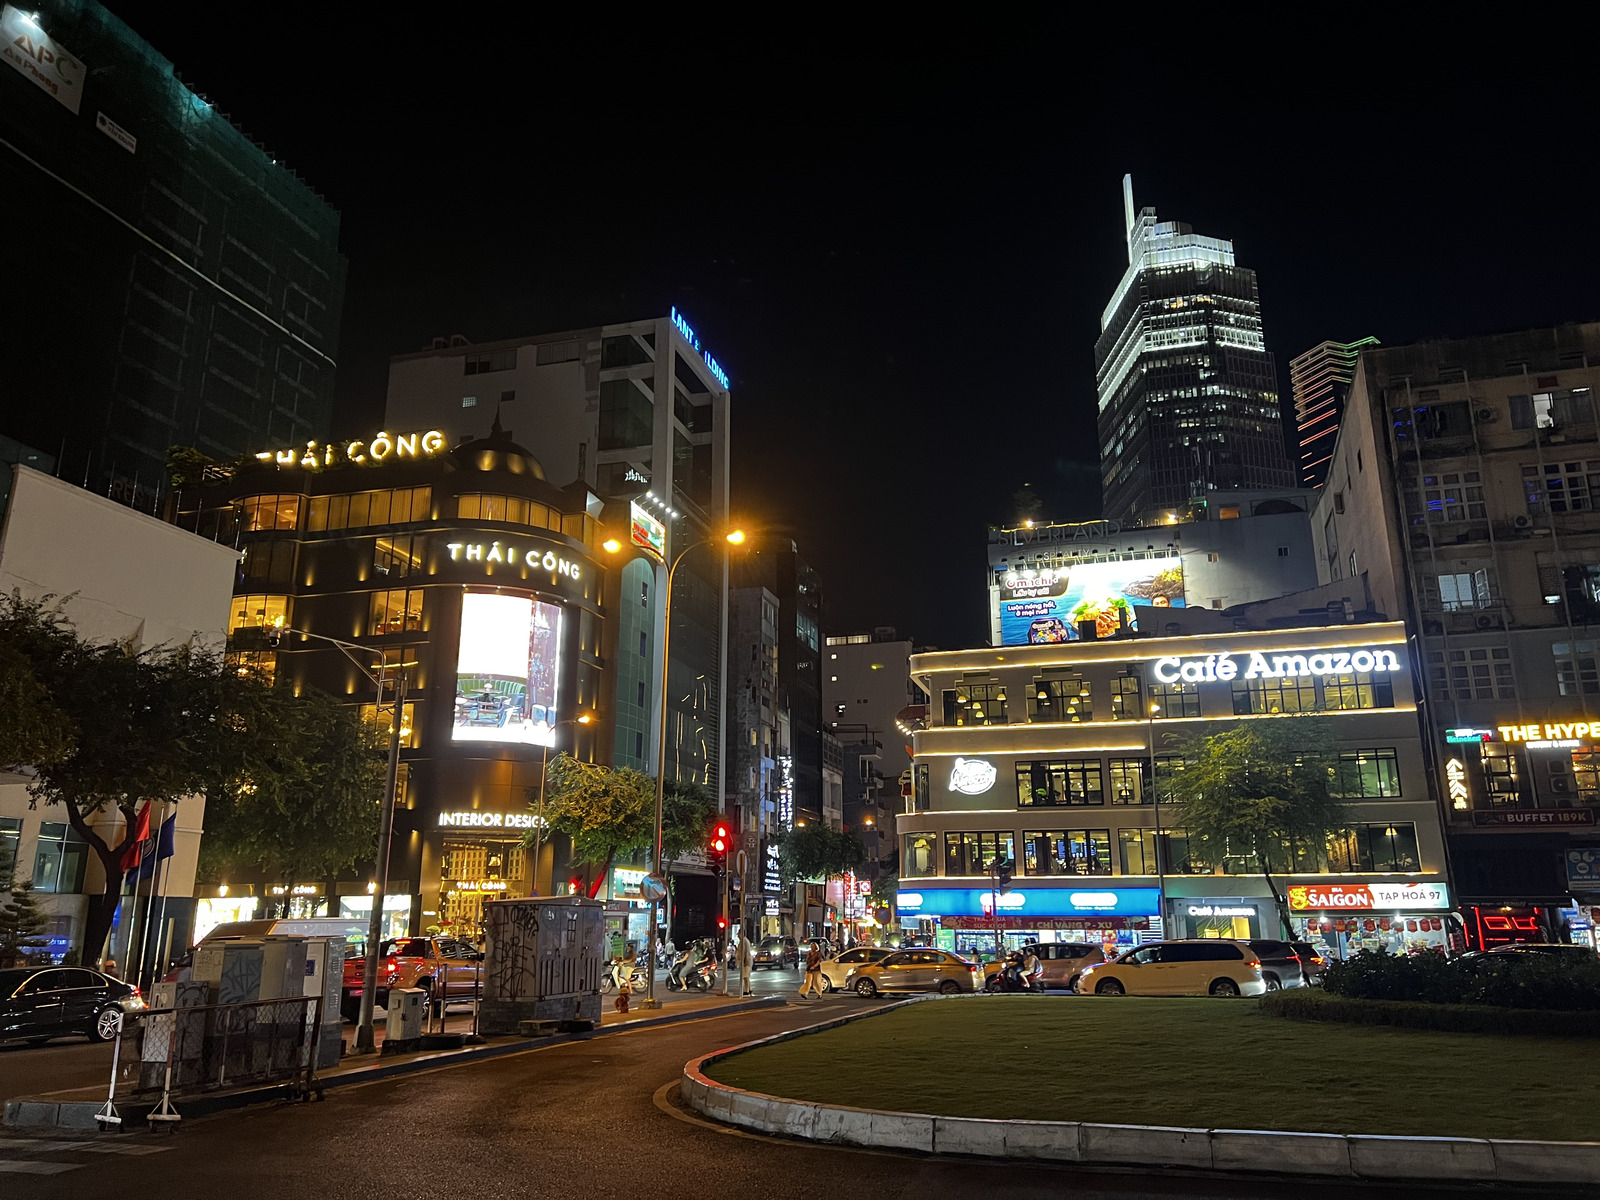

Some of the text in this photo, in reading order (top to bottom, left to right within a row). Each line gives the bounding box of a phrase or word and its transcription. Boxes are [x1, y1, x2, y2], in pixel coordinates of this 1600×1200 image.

[13, 33, 79, 86] APC
[346, 431, 443, 462] CÔNG
[998, 520, 1120, 548] SILVERLAND
[446, 541, 580, 580] THÁI CÔNG
[1027, 548, 1090, 562] HOSPIALTY
[1154, 649, 1401, 683] Café Amazon
[1498, 724, 1541, 742] THE
[1544, 721, 1600, 740] HYPE
[438, 812, 503, 827] INTERIOR
[1506, 813, 1587, 822] BUFFET 189K
[456, 881, 479, 890] THÁI
[1308, 889, 1441, 907] SAIGON TẠP HOÁ 97
